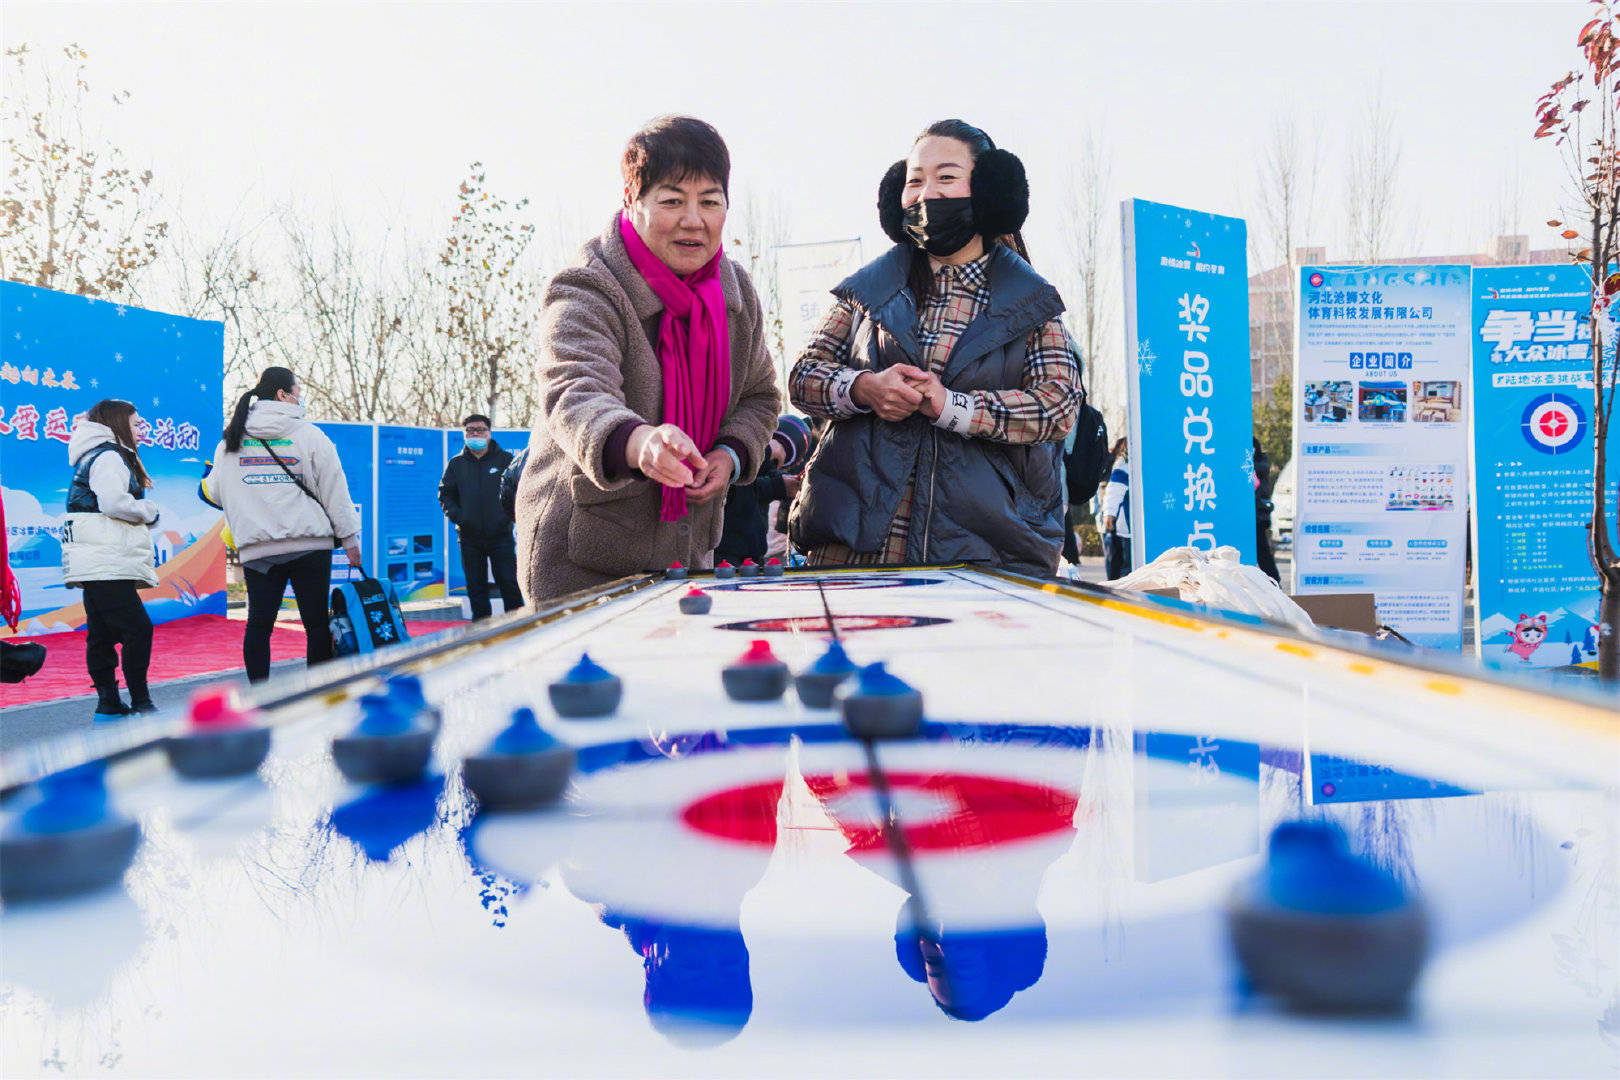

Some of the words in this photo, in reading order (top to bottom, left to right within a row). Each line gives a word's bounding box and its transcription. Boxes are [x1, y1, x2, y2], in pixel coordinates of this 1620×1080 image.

[1308, 290, 1384, 305] 河北沧狮文化
[1308, 306, 1433, 320] 体育科技发展有限公司
[1351, 353, 1411, 368] 企业简介
[1504, 343, 1592, 363] 大众冰雪
[1505, 373, 1594, 385] 陆地冰壶挑战
[1177, 293, 1217, 552] 奖品兑换点
